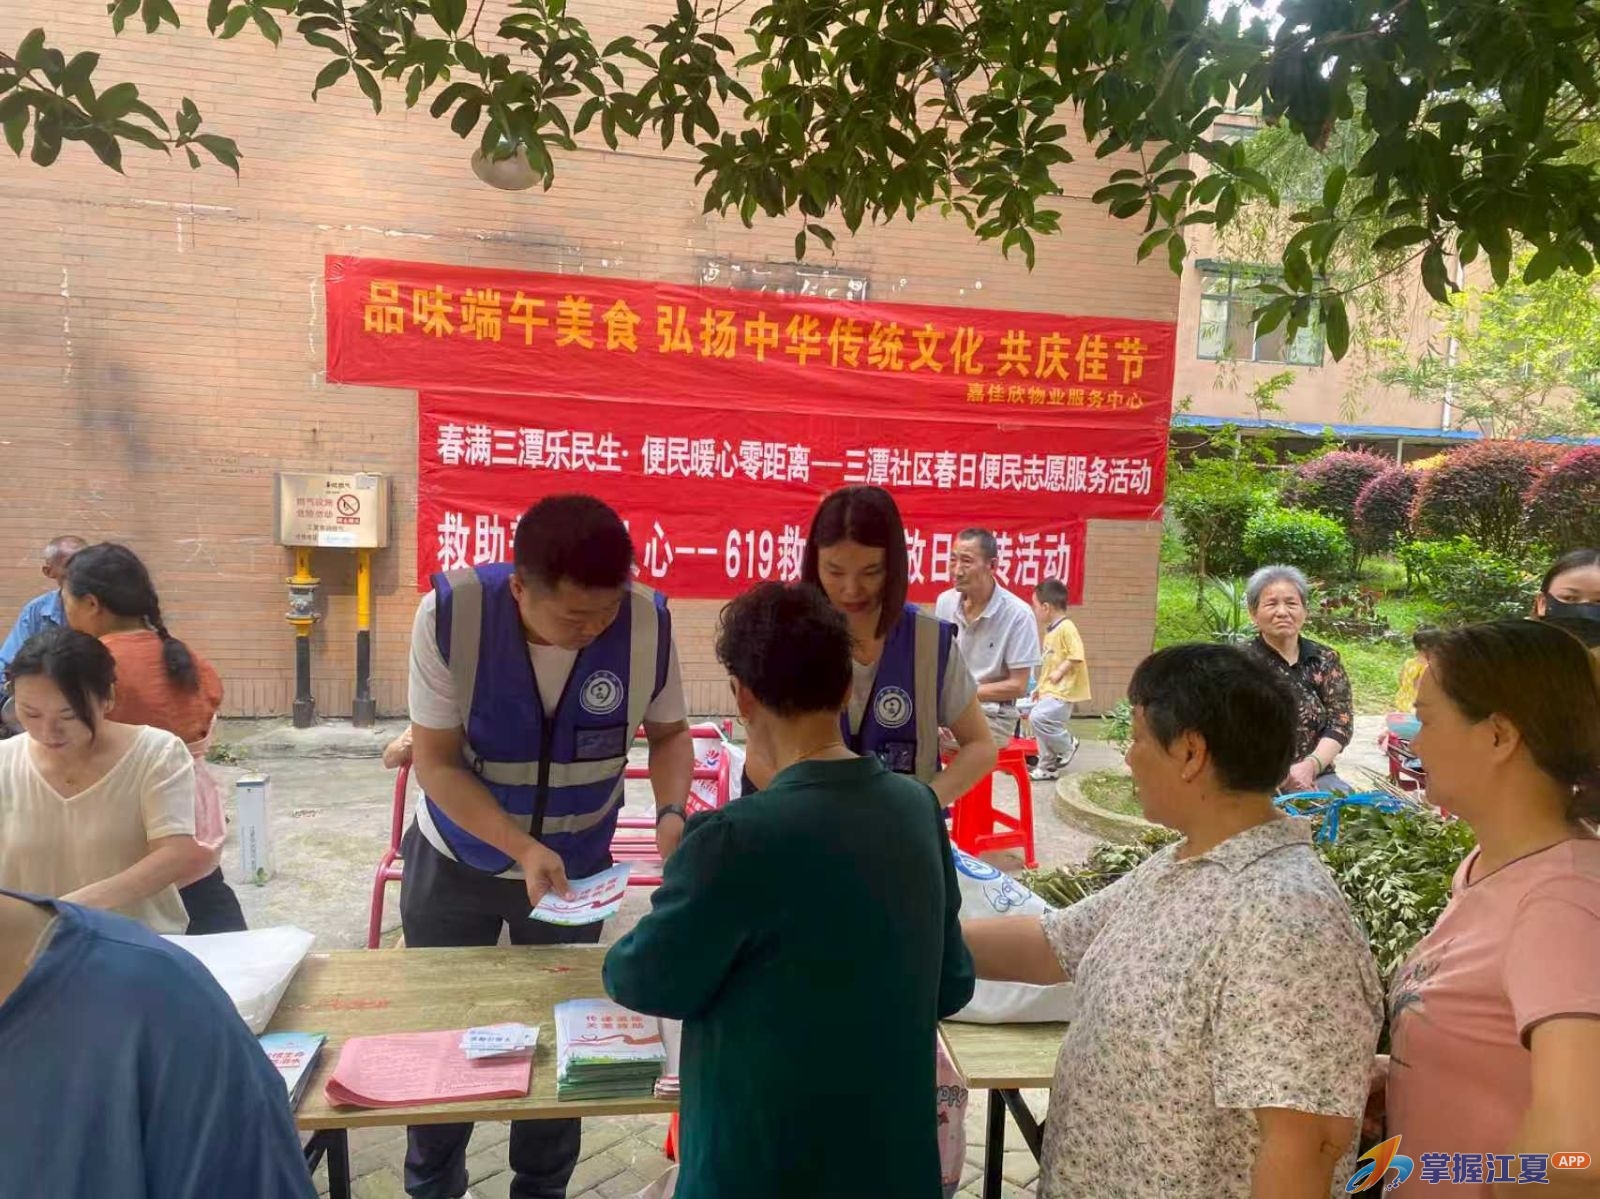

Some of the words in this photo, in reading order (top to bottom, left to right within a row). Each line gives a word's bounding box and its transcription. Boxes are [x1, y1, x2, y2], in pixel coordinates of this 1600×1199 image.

[363, 279, 642, 353] 品味端午美食
[656, 304, 985, 377] 弘扬中华传统文化
[997, 329, 1149, 385] 共庆佳节
[966, 382, 1144, 410] 嘉佳欣物业服务中心
